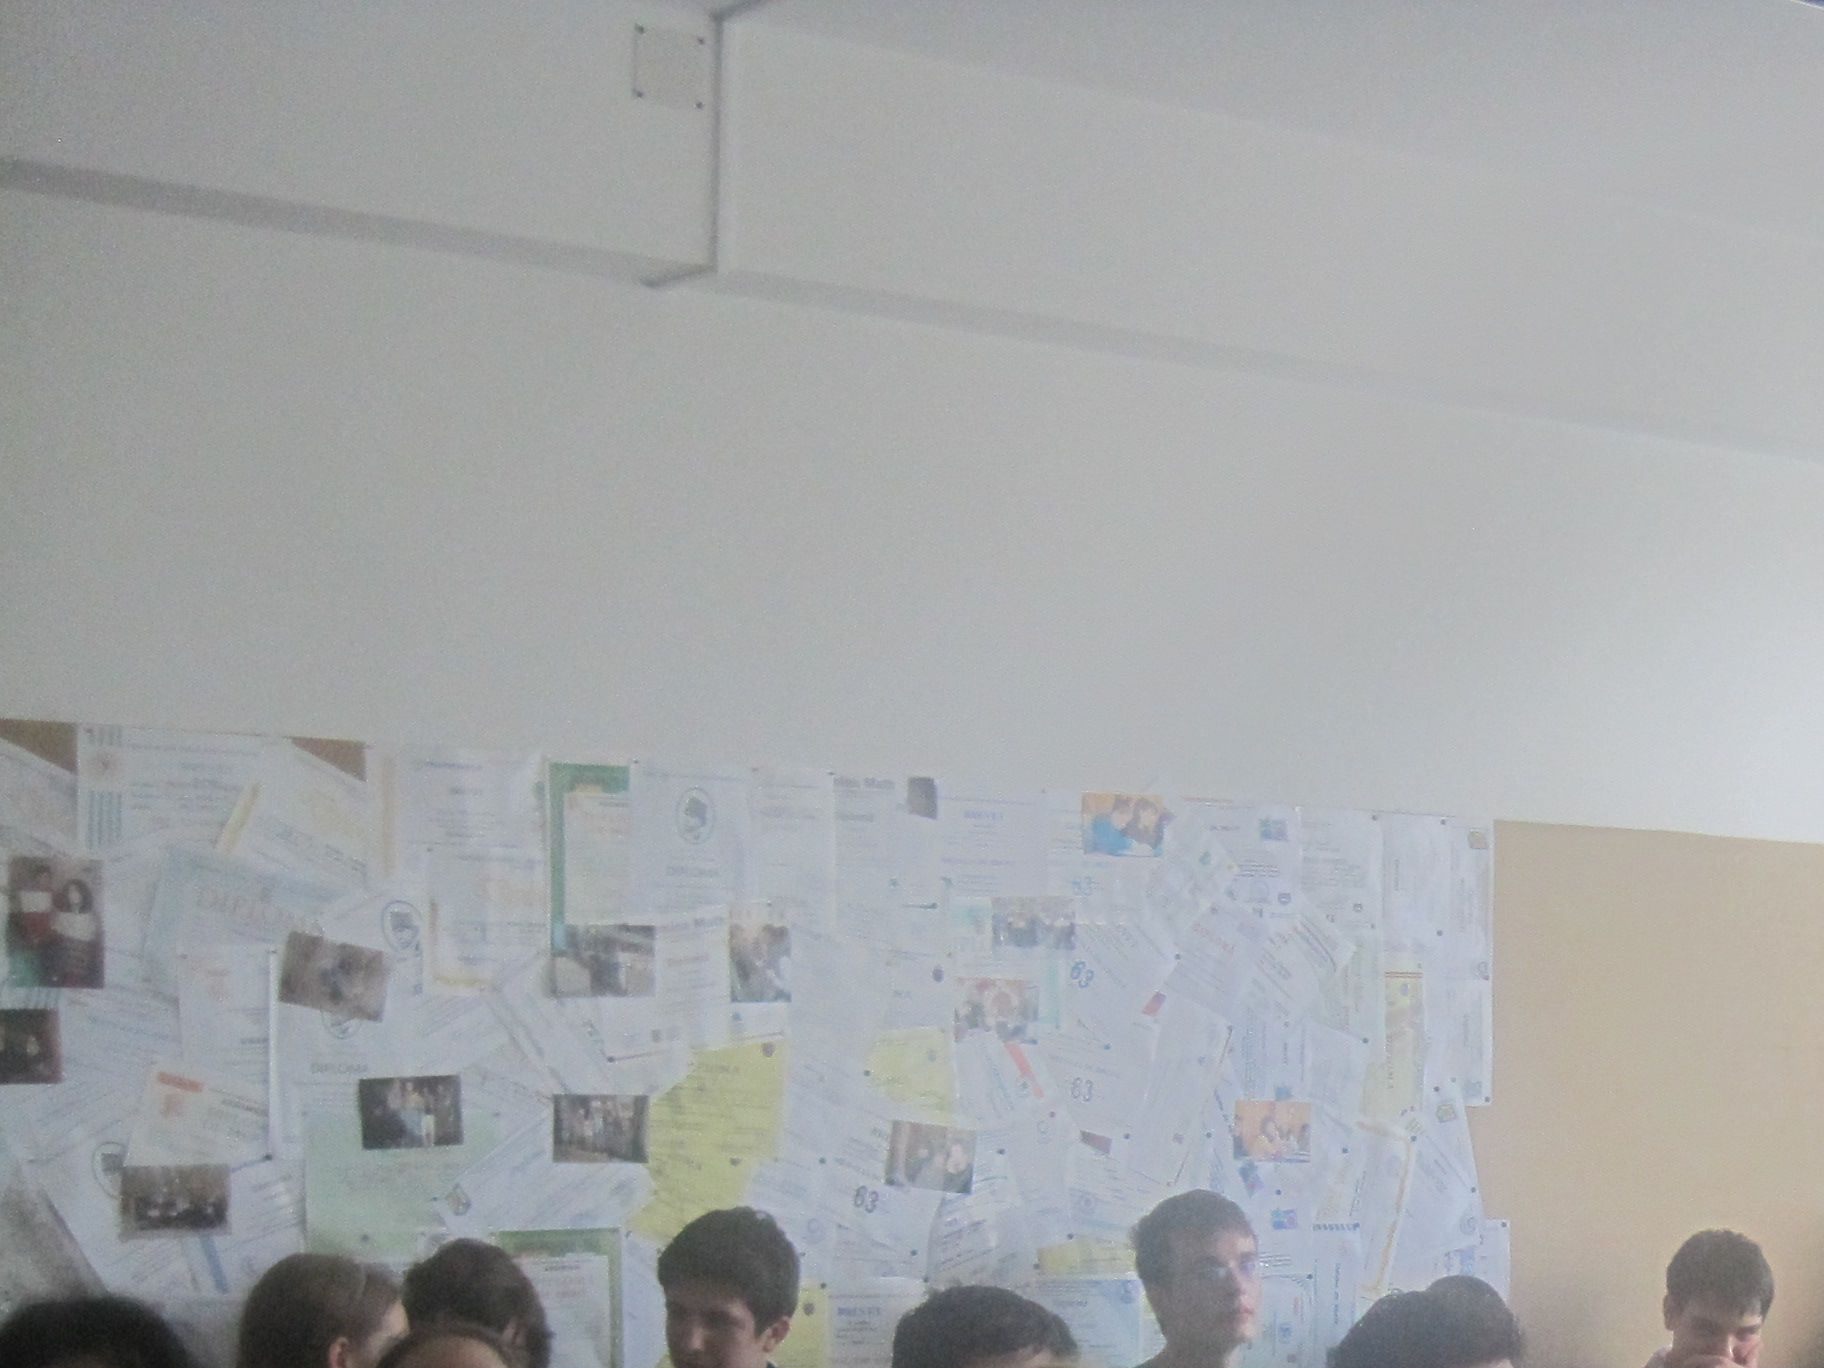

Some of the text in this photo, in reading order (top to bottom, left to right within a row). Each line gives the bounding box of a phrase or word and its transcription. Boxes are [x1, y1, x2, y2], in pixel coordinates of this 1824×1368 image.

[1070, 961, 1094, 989] 63
[1071, 1077, 1094, 1102] 63
[853, 1185, 879, 1213] 63
